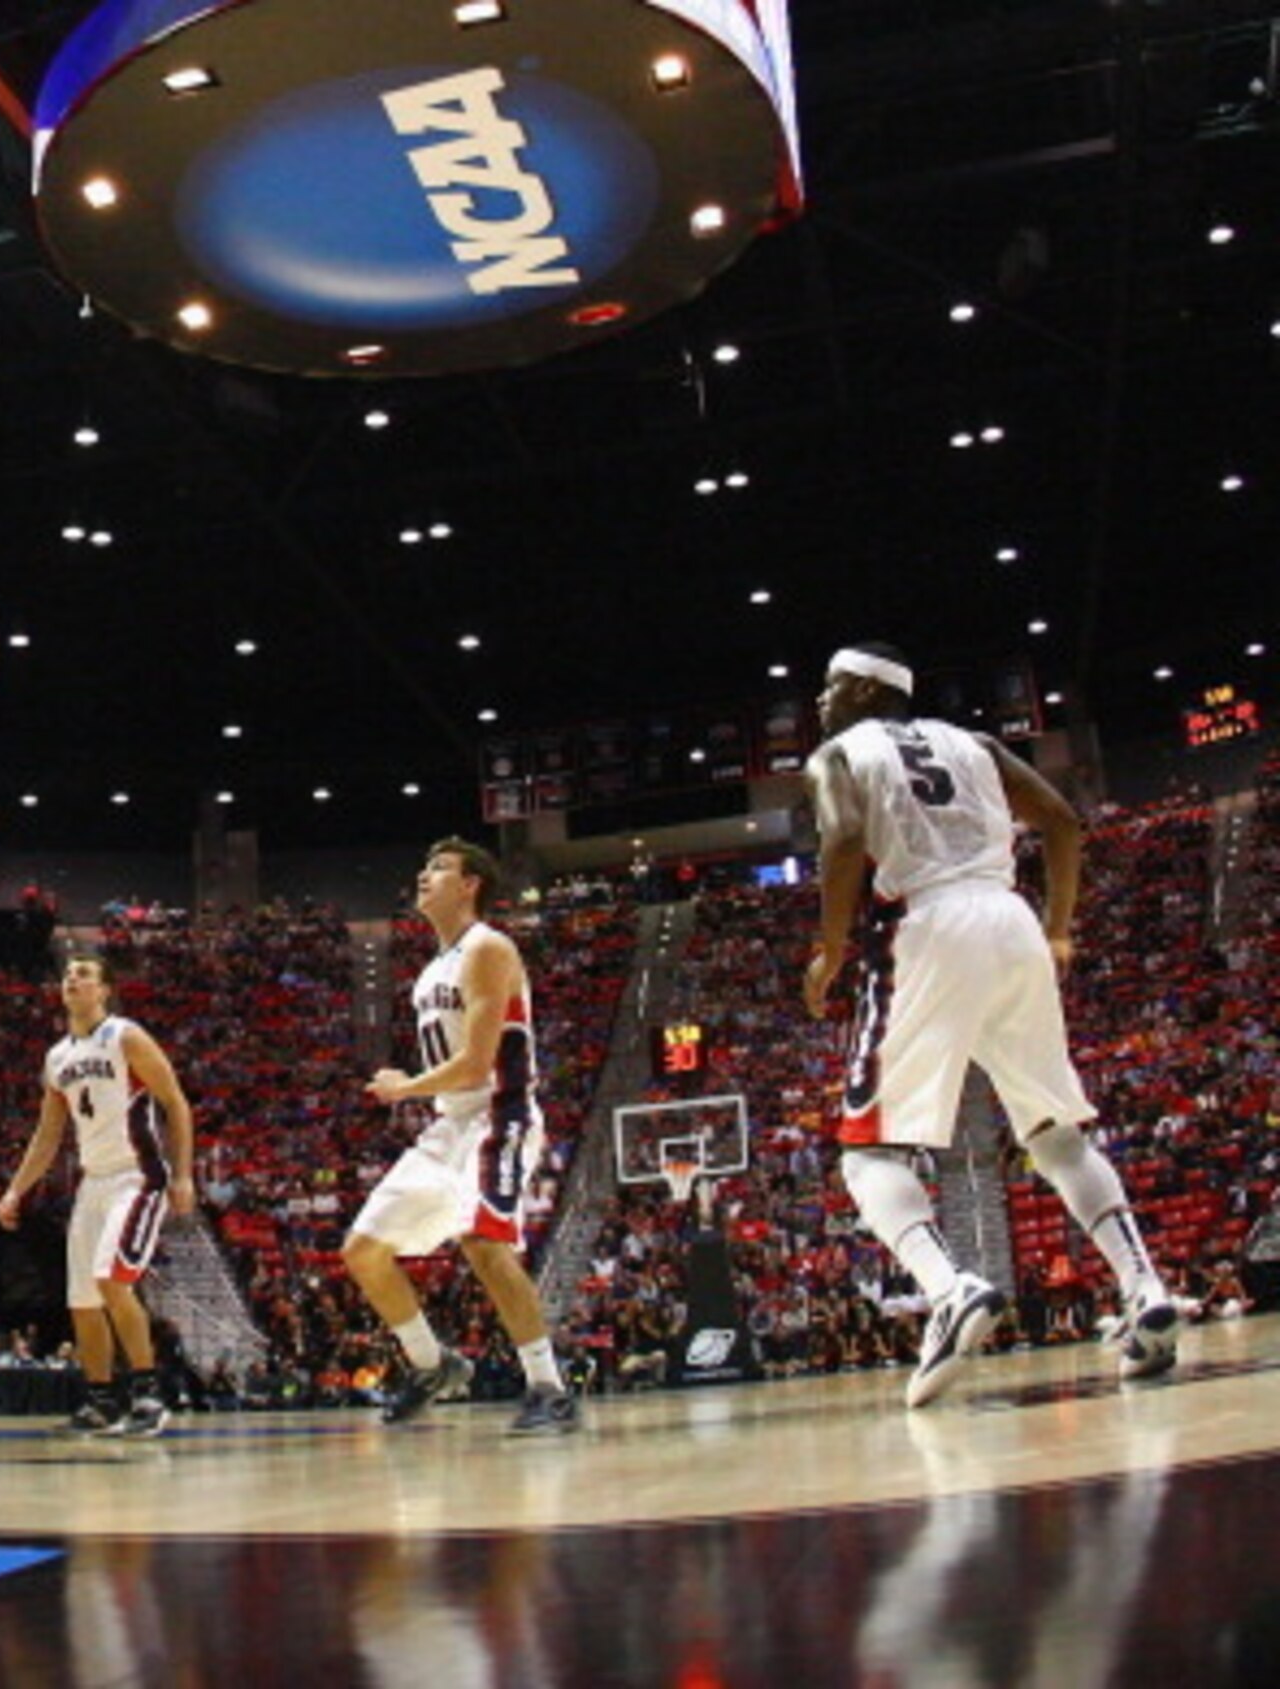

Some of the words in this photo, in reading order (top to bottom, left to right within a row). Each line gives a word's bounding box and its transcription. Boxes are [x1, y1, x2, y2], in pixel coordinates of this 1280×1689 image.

[379, 66, 581, 295] NCAA
[898, 744, 955, 806] 5
[79, 1086, 94, 1119] 4
